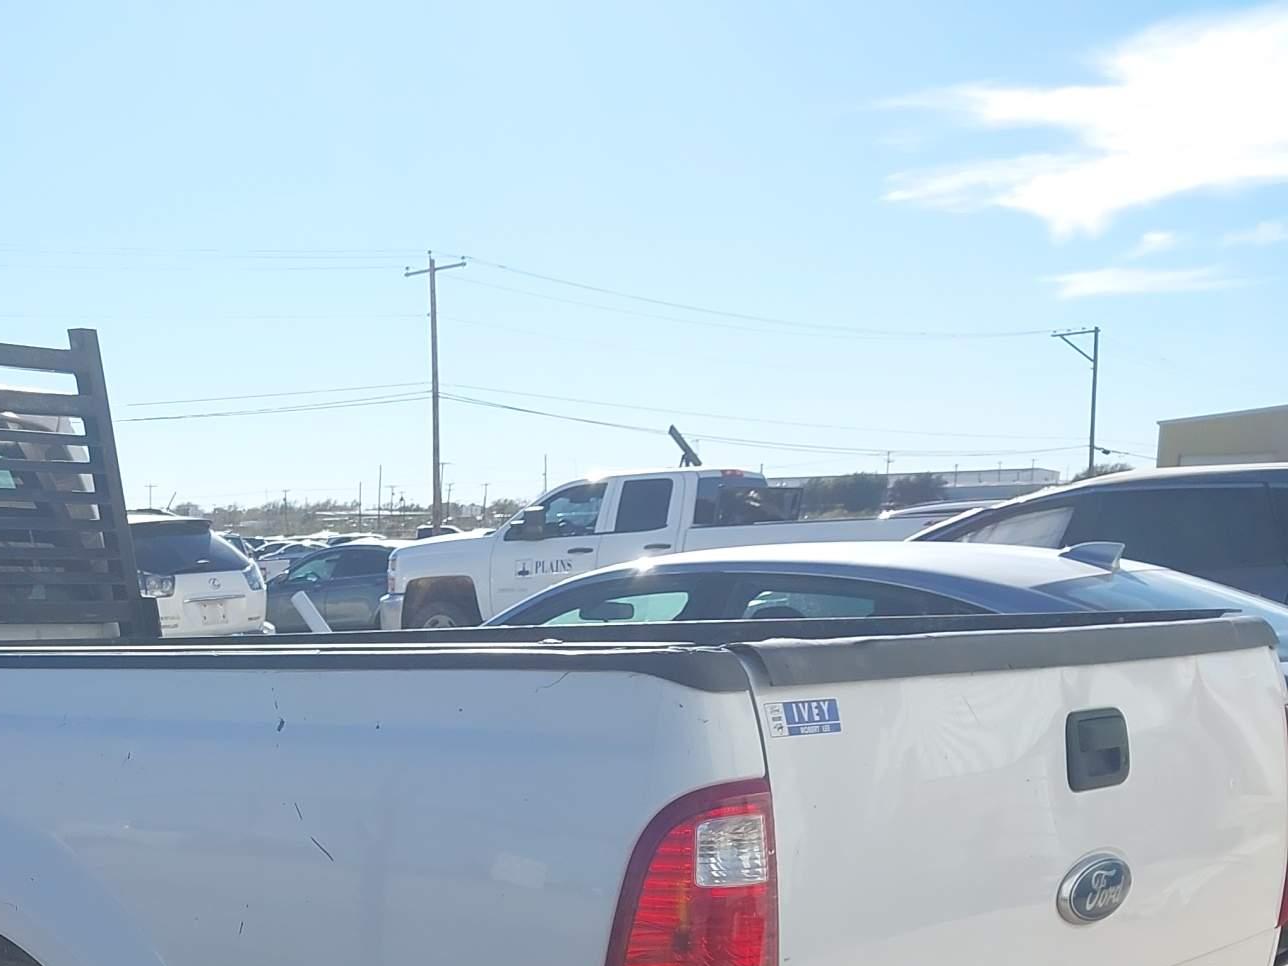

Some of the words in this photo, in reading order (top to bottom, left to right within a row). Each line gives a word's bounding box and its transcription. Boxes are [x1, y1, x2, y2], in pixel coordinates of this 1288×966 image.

[535, 559, 573, 575] PLAINS
[792, 701, 829, 723] IVEY
[1086, 869, 1124, 911] Ford
